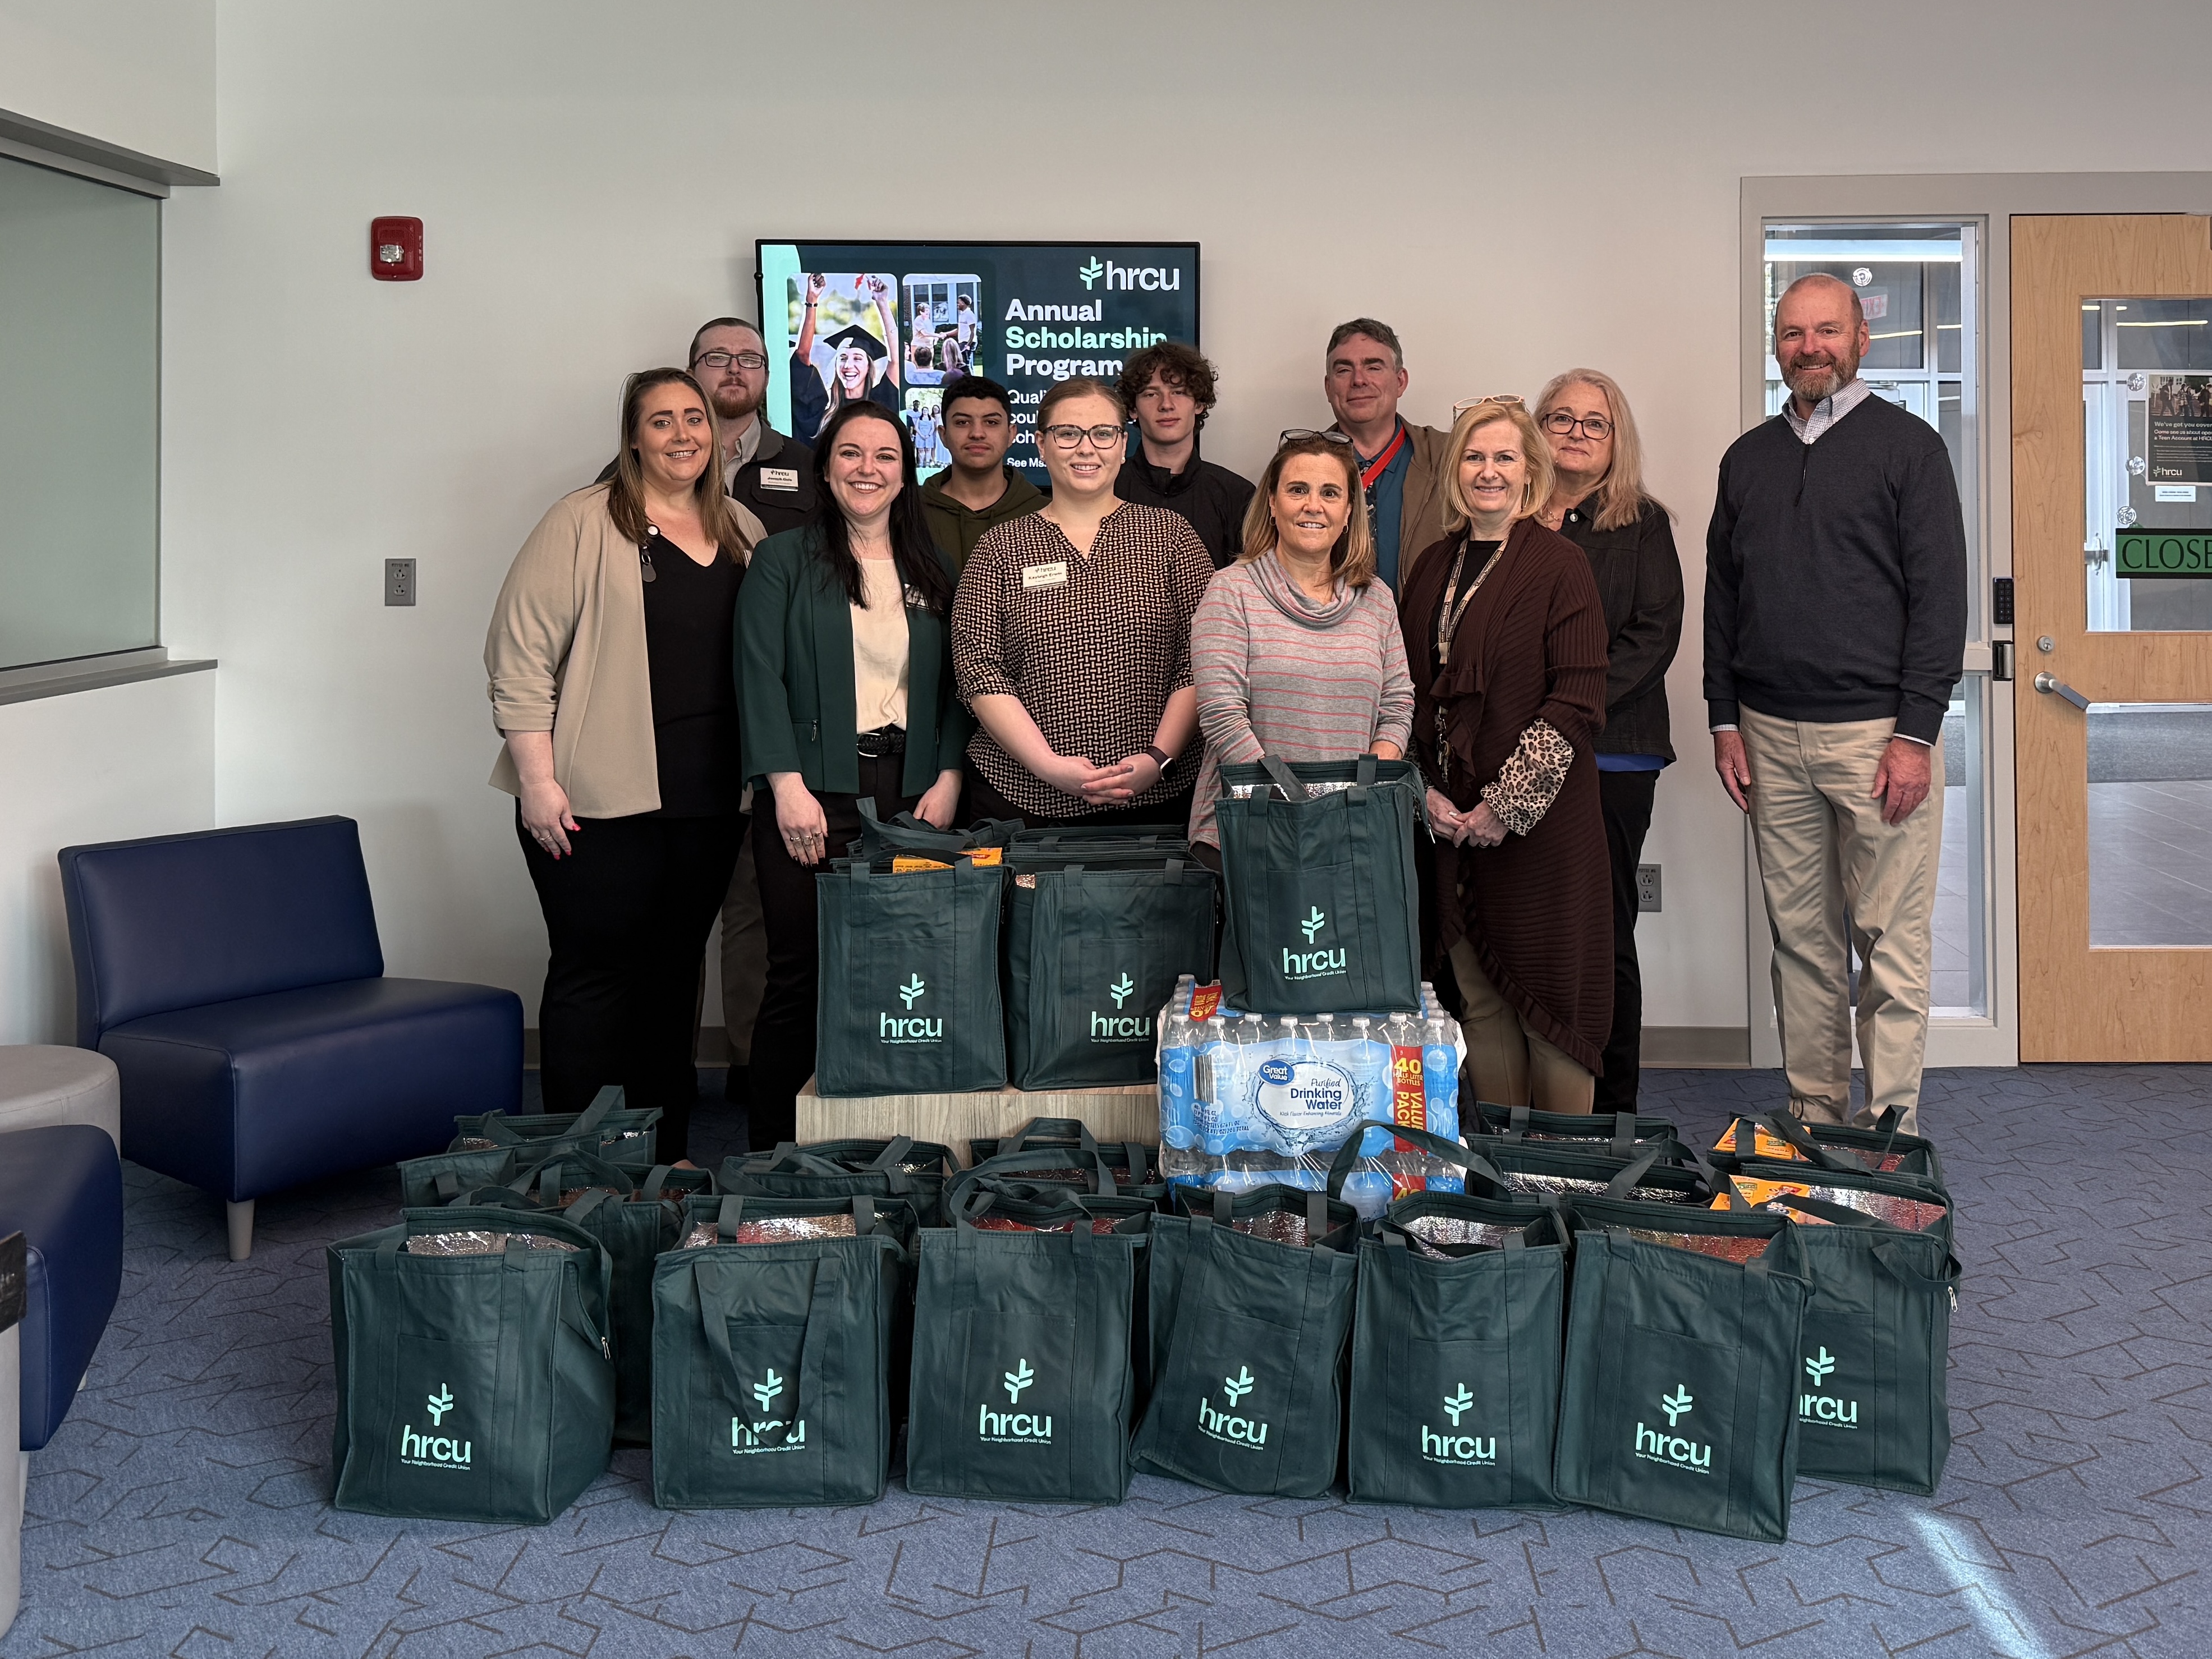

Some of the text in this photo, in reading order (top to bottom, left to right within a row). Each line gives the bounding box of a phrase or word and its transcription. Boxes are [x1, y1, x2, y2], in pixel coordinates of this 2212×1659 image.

[1107, 260, 1180, 291] hrcu
[1005, 298, 1102, 321] Annual
[1007, 353, 1123, 381] Program
[1007, 457, 1027, 467] See
[2161, 467, 2182, 476] hrcu
[2122, 539, 2212, 569] CLOSE
[1283, 948, 1346, 973] hrcu
[880, 1012, 943, 1037] hrcu
[1091, 1011, 1150, 1036] hrcu
[1263, 1064, 1288, 1075] Great
[1394, 1058, 1421, 1074] 40
[1291, 1088, 1342, 1101] Drinking
[1311, 1078, 1342, 1088] Purified
[1305, 1099, 1342, 1110] Water
[1395, 1187, 1421, 1201] 4
[979, 1404, 1052, 1437] hrcu
[1199, 1397, 1268, 1444] hrcu
[1799, 1417, 1828, 1426] eighborhood
[401, 1424, 471, 1463] hrcu
[1422, 1425, 1495, 1459] hrcu
[1635, 1422, 1711, 1467] hrcu
[1679, 1463, 1695, 1472] Credit
